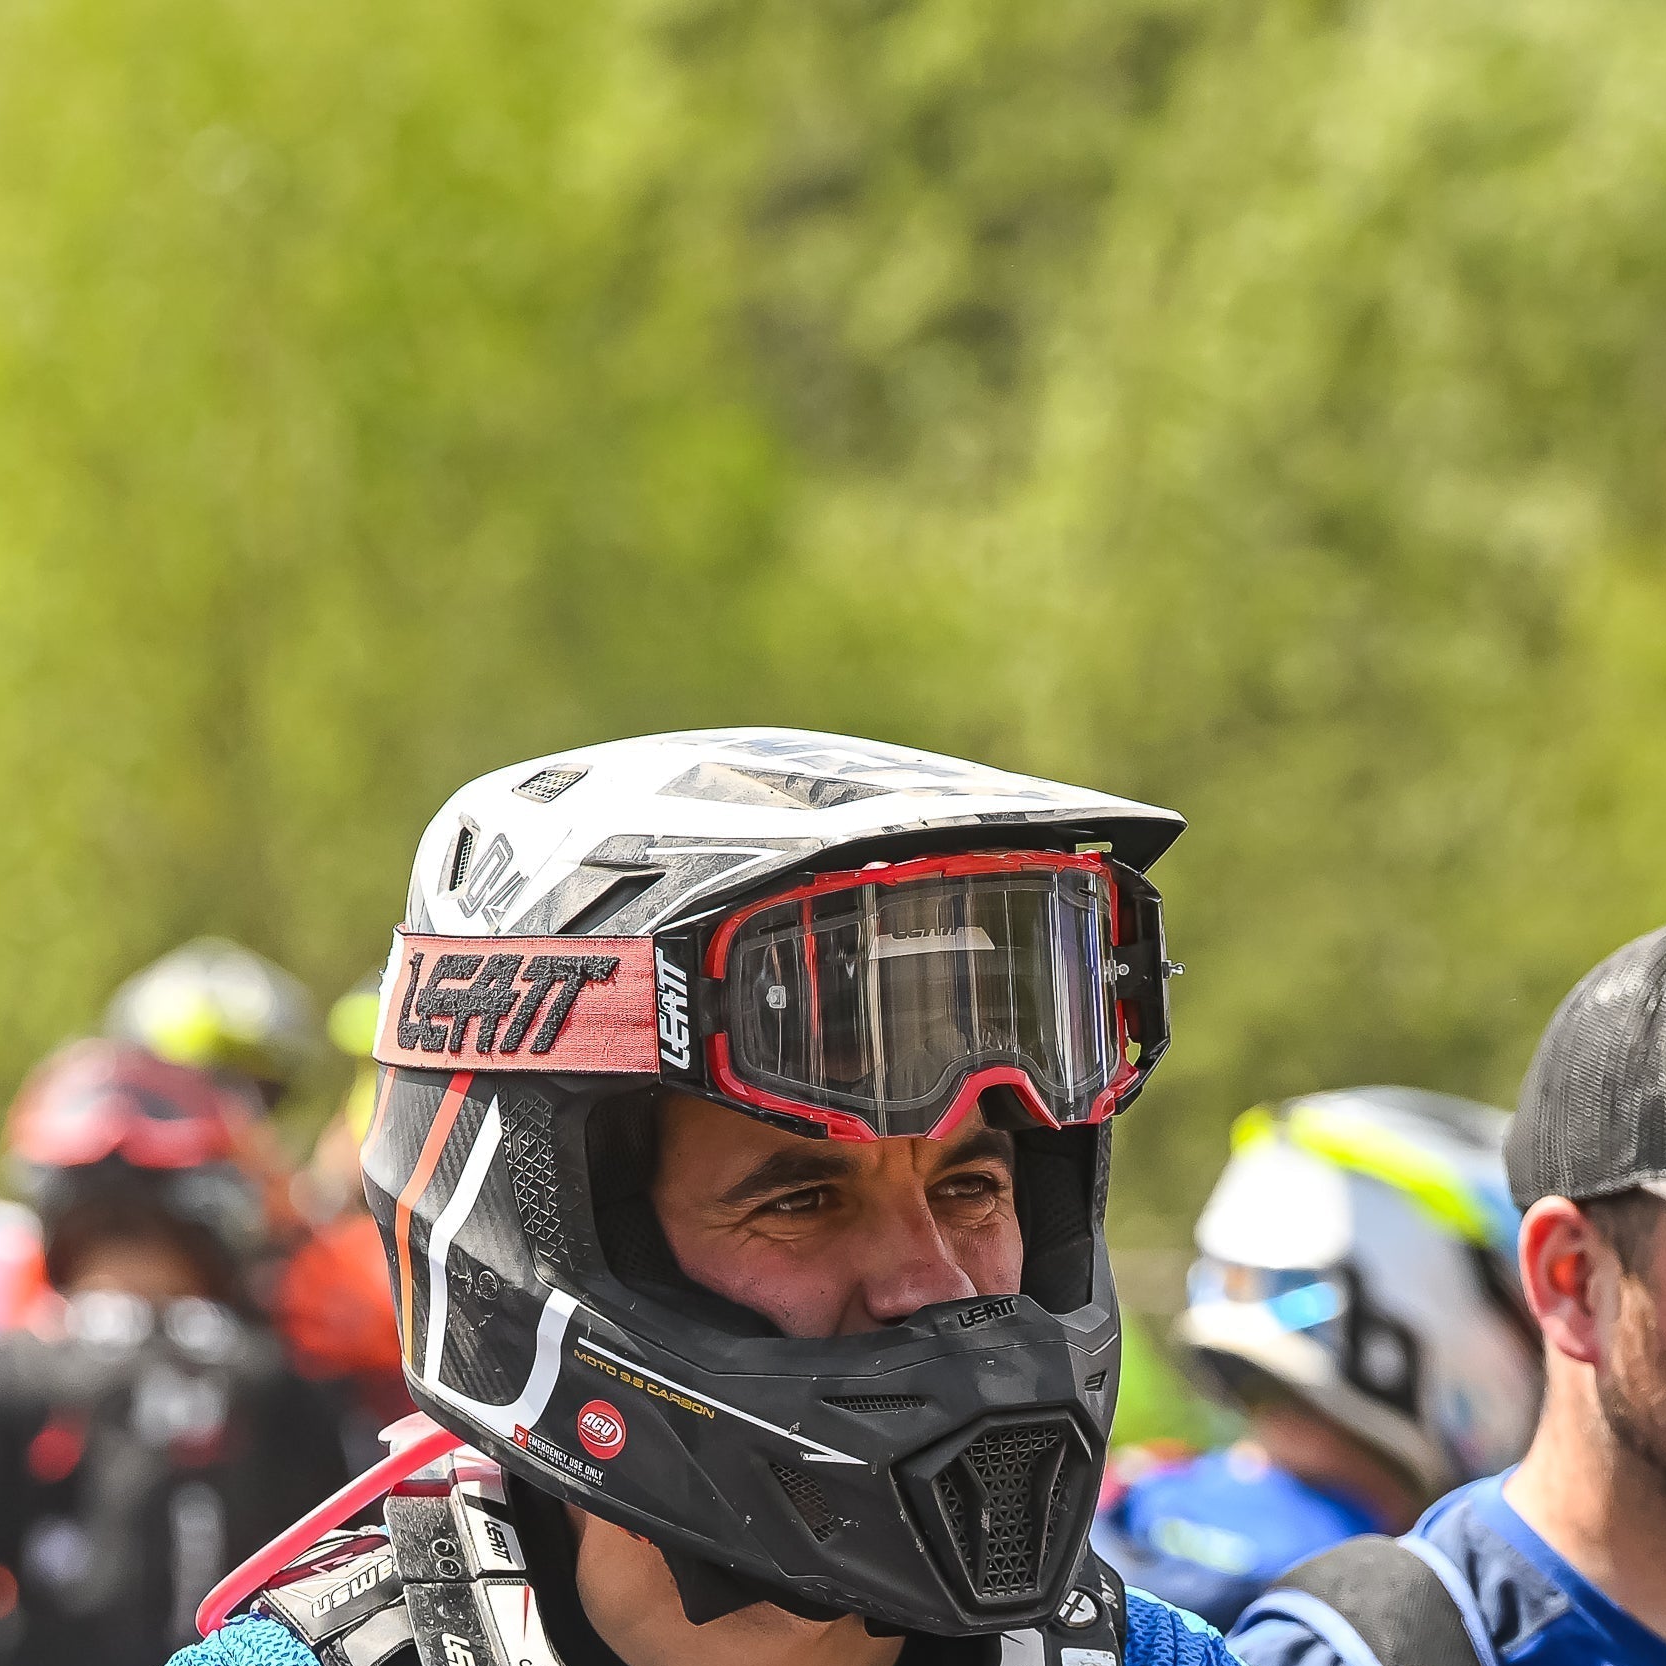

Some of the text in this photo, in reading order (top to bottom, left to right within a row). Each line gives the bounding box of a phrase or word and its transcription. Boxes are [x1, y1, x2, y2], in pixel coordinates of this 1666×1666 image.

[396, 951, 621, 1055] LEATT
[655, 945, 692, 1071] LEATT
[957, 1297, 1016, 1329] LEATT
[573, 1348, 715, 1420] MOTO 9.5 CARBON
[581, 1412, 616, 1437] ACU
[527, 1433, 604, 1481] EMERGENCY USE ONLY
[482, 1518, 513, 1564] LEATT
[311, 1555, 395, 1618] USWE
